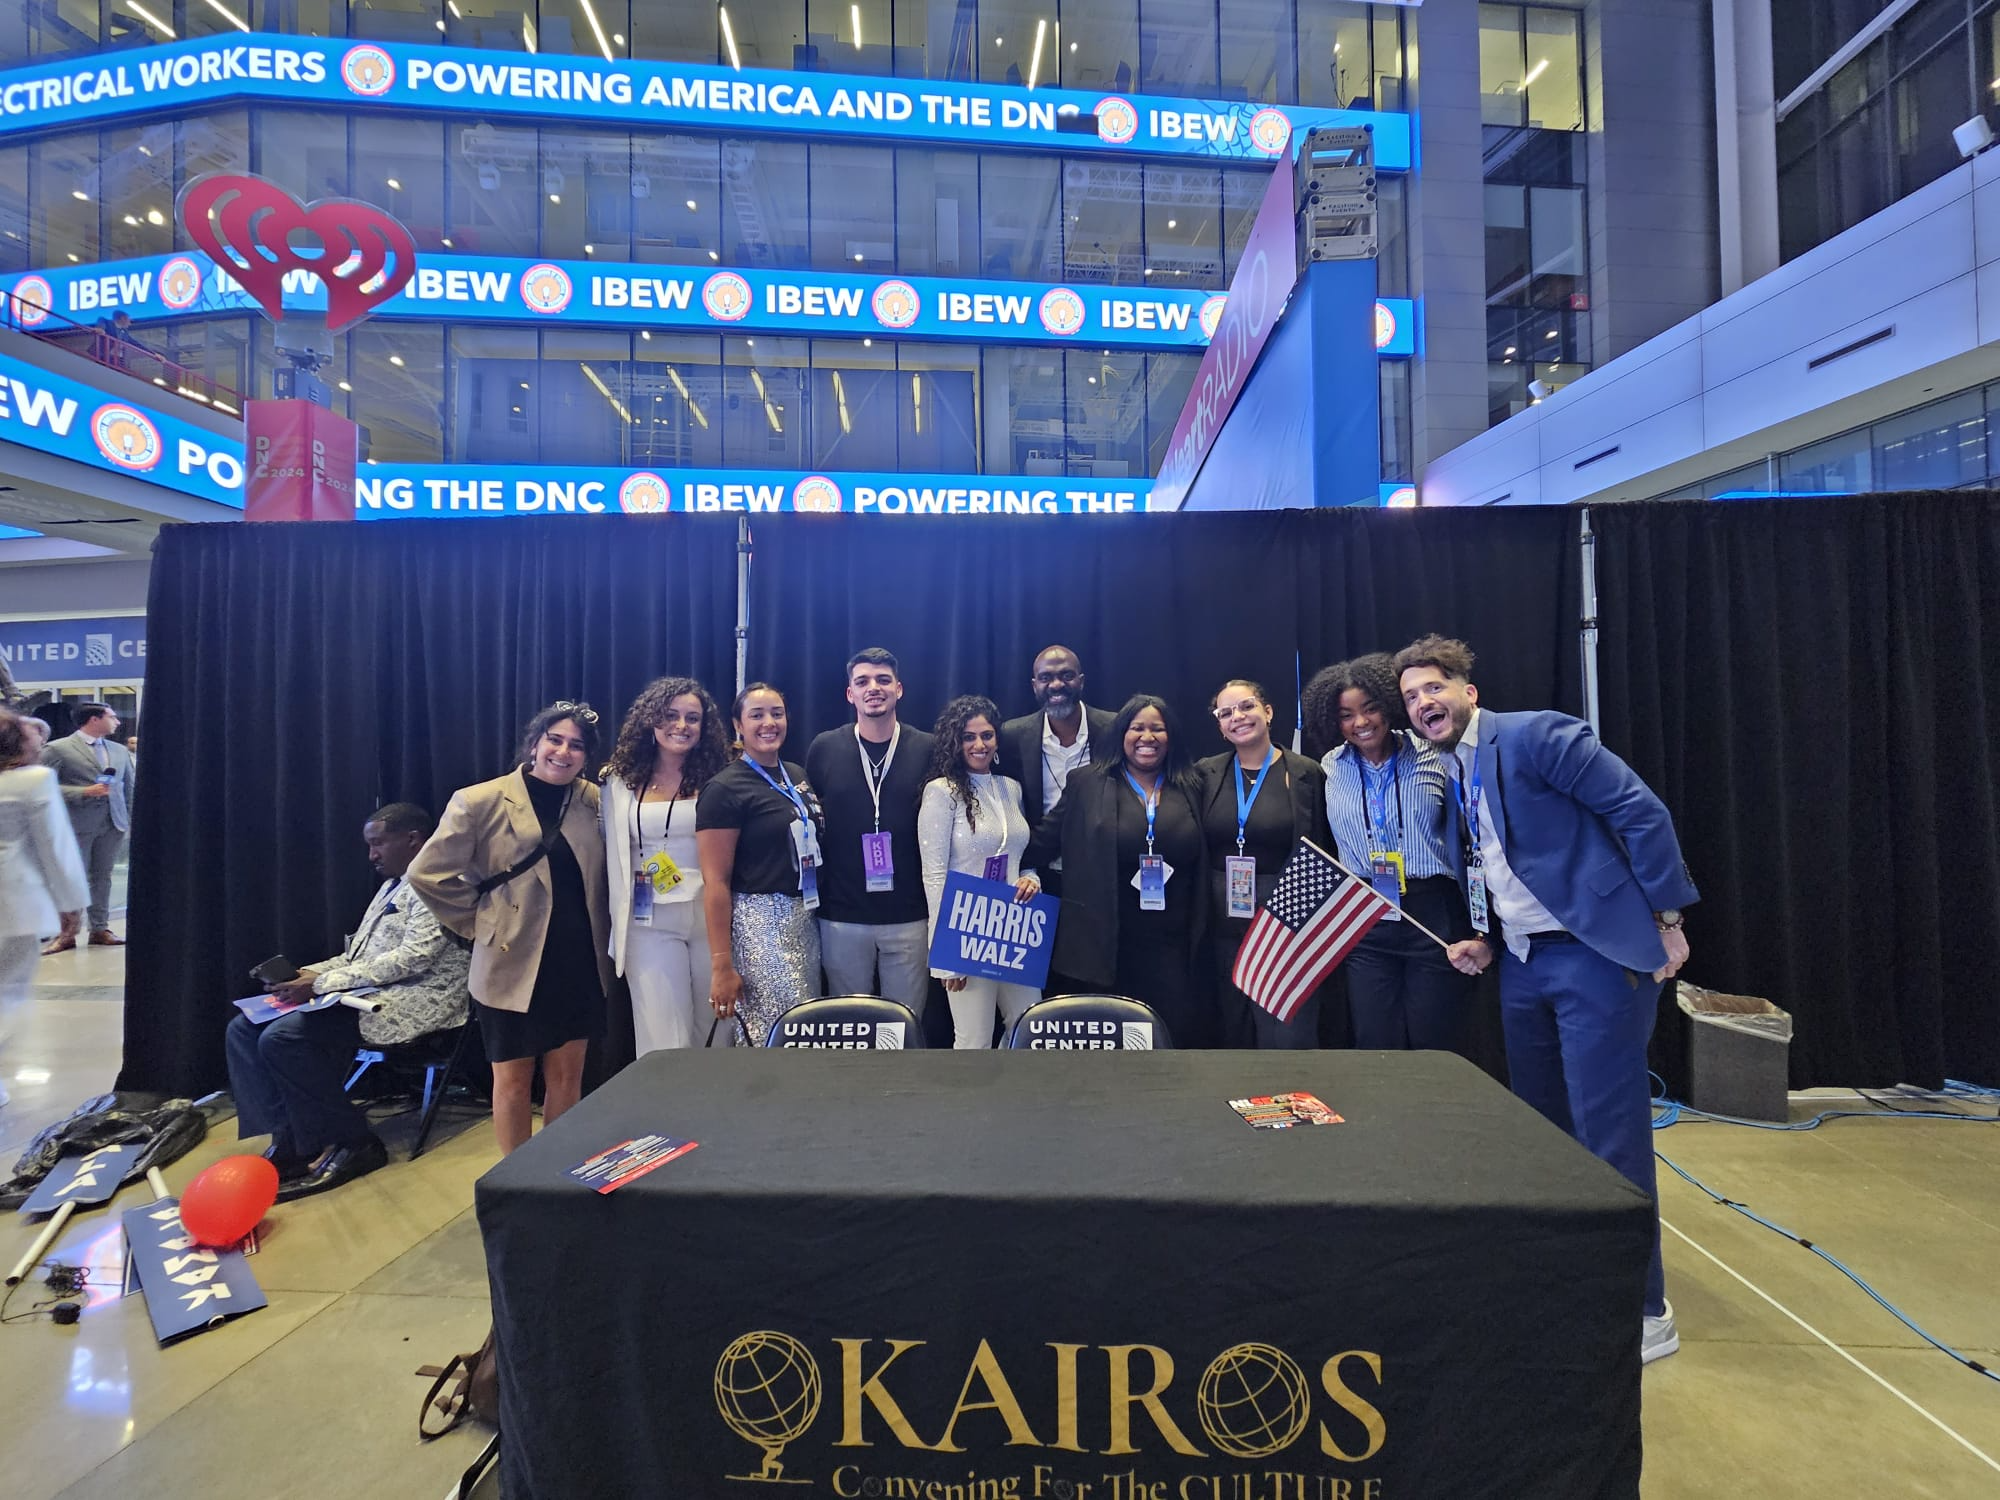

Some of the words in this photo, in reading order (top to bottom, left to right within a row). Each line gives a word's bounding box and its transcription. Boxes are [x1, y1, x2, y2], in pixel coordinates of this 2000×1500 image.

[0, 66, 134, 115] CTRICAL
[139, 47, 326, 92] WORKERS
[407, 60, 632, 105] POWERING
[641, 76, 822, 117] AMERICA
[828, 88, 913, 121] AND
[919, 94, 991, 128] THE
[1150, 109, 1238, 142] IBEW
[69, 271, 151, 311] IBEW
[404, 269, 511, 302] IBEW
[592, 276, 693, 310] IBEW
[765, 284, 864, 316] IBEW
[937, 292, 1031, 324] IBEW
[1101, 300, 1191, 331] IBEW
[256, 436, 270, 478] DNC
[271, 468, 305, 478] 2024
[313, 440, 325, 483] DNC
[423, 480, 504, 511] THE
[516, 481, 606, 513] DNC
[685, 484, 785, 512] IBEW
[855, 488, 1057, 513] POWERING
[1066, 492, 1134, 513] THE
[872, 841, 884, 866] KDH
[948, 890, 1047, 948] HARRIS
[960, 935, 1027, 970] WALZ
[784, 1023, 870, 1036] UNITED
[1030, 1021, 1117, 1034] UNITED
[1031, 1039, 1116, 1050] CENTER
[831, 1338, 1387, 1462] KAIROS
[1103, 1468, 1167, 1500] The
[1179, 1472, 1382, 1500] CULTURE
